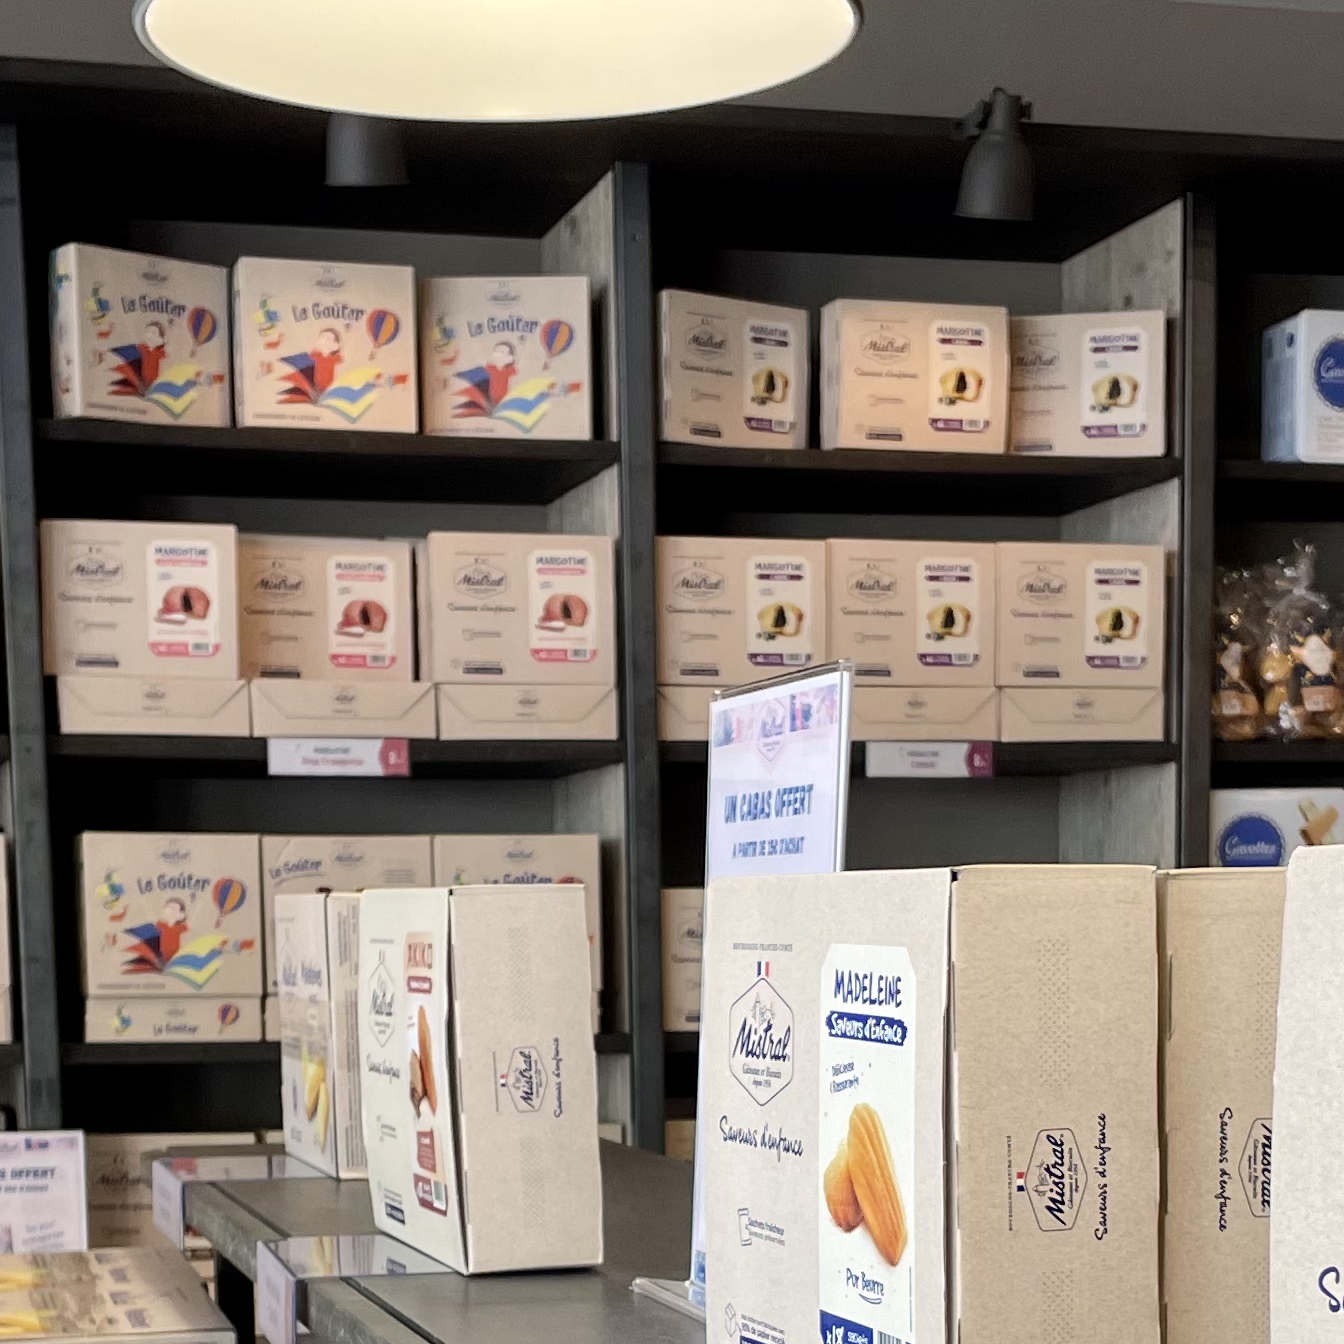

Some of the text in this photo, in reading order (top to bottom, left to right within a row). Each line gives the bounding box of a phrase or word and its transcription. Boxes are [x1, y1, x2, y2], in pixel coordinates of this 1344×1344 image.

[311, 300, 365, 324] Goûter
[724, 784, 814, 824] UN CABAS OFFERT
[137, 872, 211, 895] Le Goûter
[834, 968, 902, 1008] MADELEINE
[732, 1017, 789, 1062] Mistral
[831, 1013, 902, 1043] Saveurs d'Enfance
[519, 1050, 532, 1109] Mistral
[719, 1115, 803, 1162] Saveurs d'enfance
[1044, 1133, 1066, 1226] Mistral
[1093, 1112, 1112, 1240] Saveurs d'enfance
[1214, 1107, 1234, 1232] Saveurs d'enfance
[846, 1267, 884, 1296] Pur Beurre
